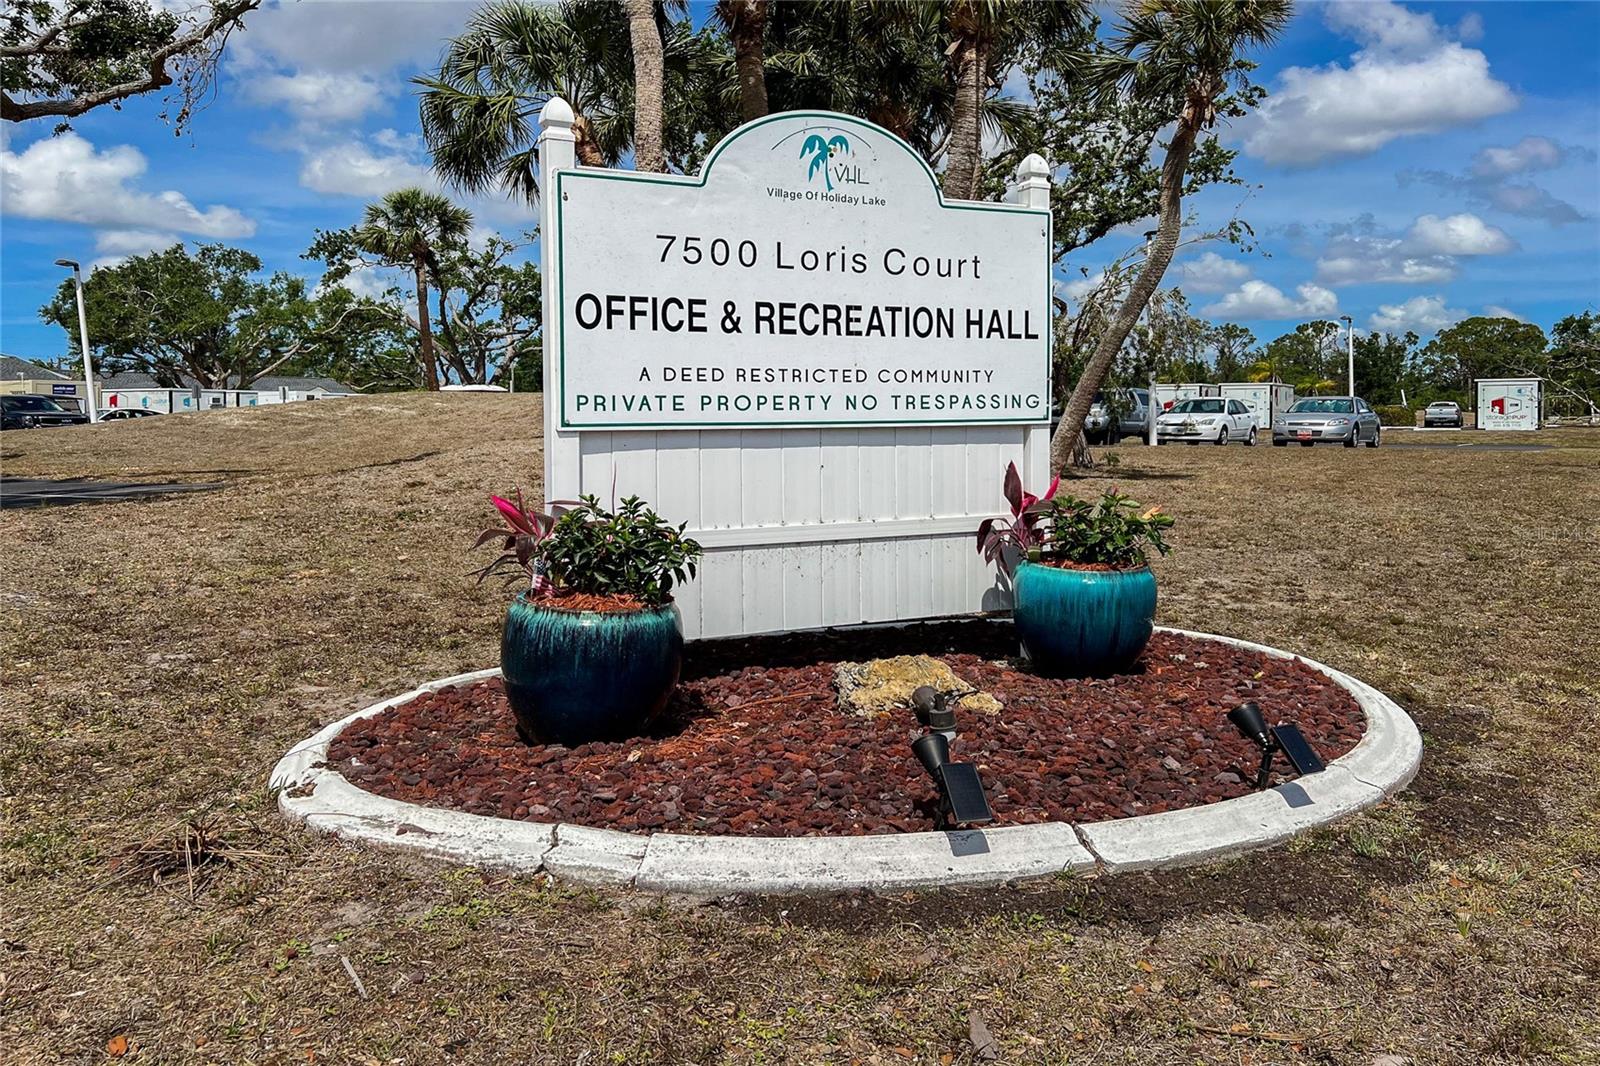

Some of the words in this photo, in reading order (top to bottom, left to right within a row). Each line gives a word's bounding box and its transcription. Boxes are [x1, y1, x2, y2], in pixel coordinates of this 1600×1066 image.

[834, 164, 870, 185] VHL
[766, 187, 803, 201] Village
[805, 190, 818, 201] Of
[821, 192, 859, 207] Holiday
[862, 195, 886, 207] Lake
[656, 234, 757, 267] 7500
[776, 241, 867, 274] Loris
[883, 248, 981, 279] Court
[575, 293, 708, 332] OFFICE
[720, 300, 743, 334] &
[754, 301, 954, 338] RECREATION
[965, 308, 1039, 340] HALL
[639, 366, 651, 382] A
[663, 367, 725, 382] DEED
[736, 368, 868, 383] RESTRICTED
[877, 369, 994, 383] COMMUNITY
[576, 394, 685, 412] PRIVATE
[700, 394, 832, 411] PROPERTY
[845, 394, 877, 411] NO
[891, 394, 1040, 410] TRESPASSING
